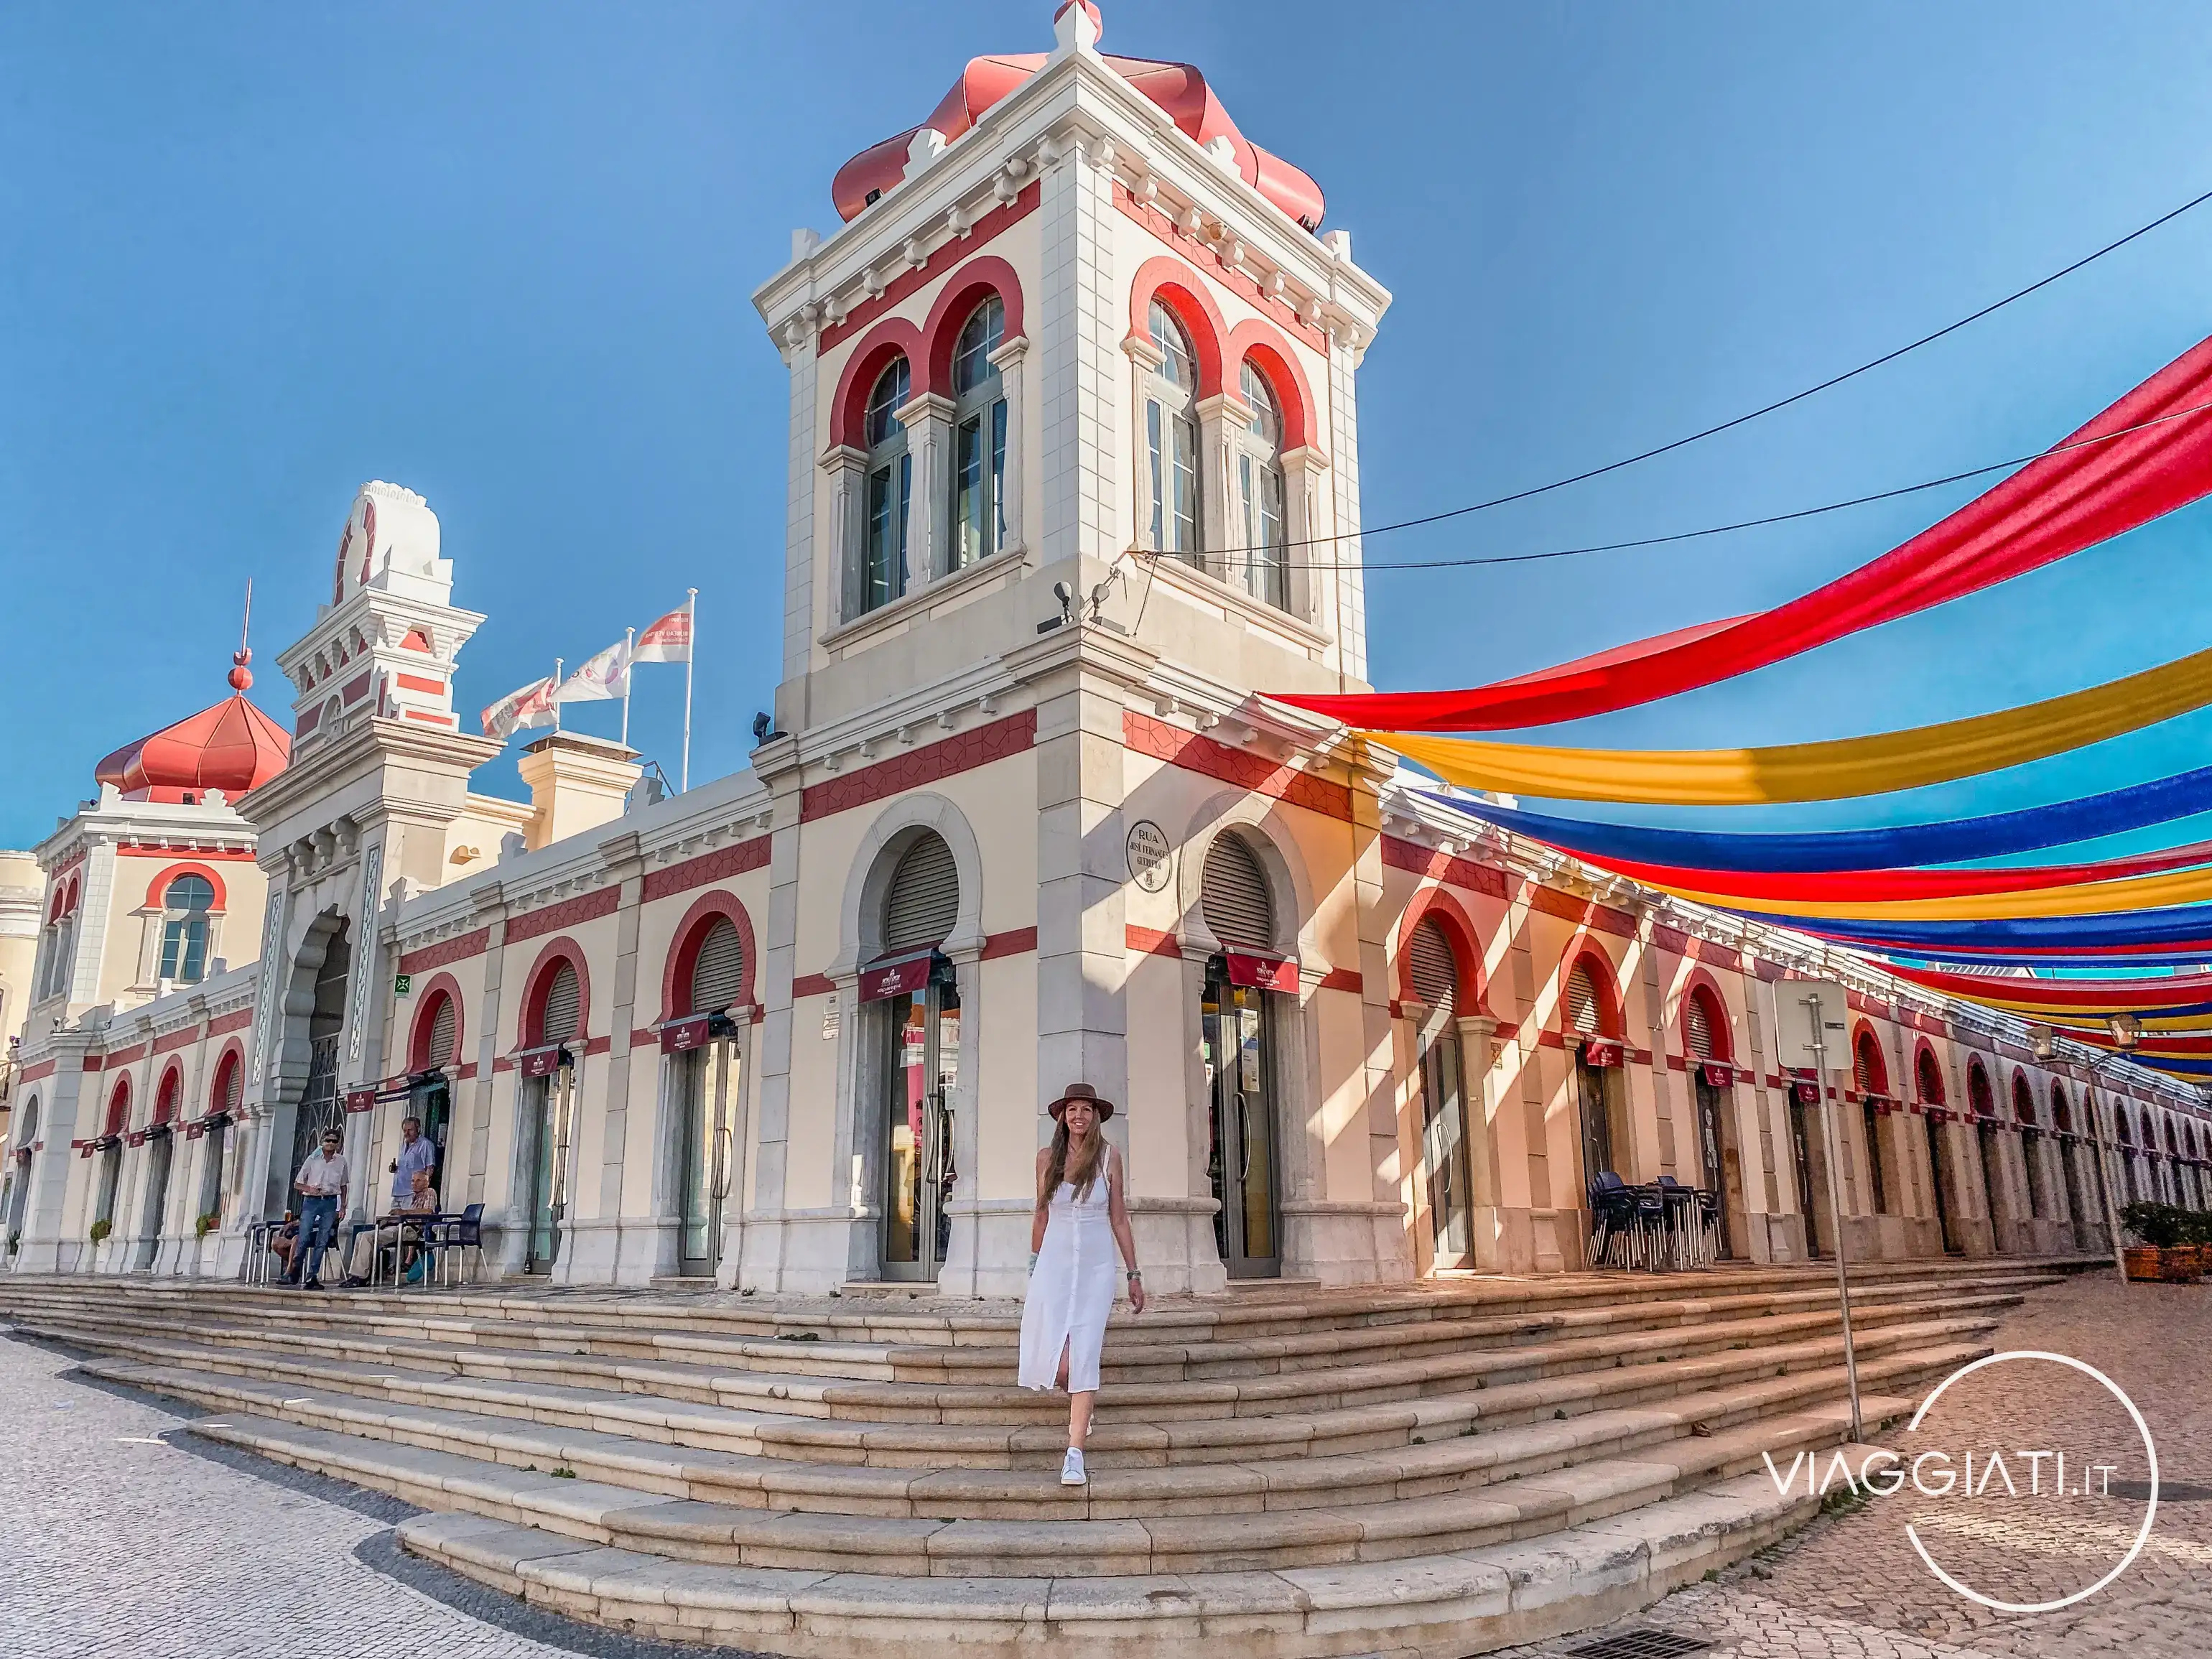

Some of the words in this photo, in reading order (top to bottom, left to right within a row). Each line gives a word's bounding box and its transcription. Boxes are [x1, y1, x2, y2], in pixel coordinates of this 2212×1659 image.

[1139, 830, 1159, 844] RUA
[1129, 841, 1141, 852] JOSÉ
[1143, 845, 1168, 860] FERNANDES
